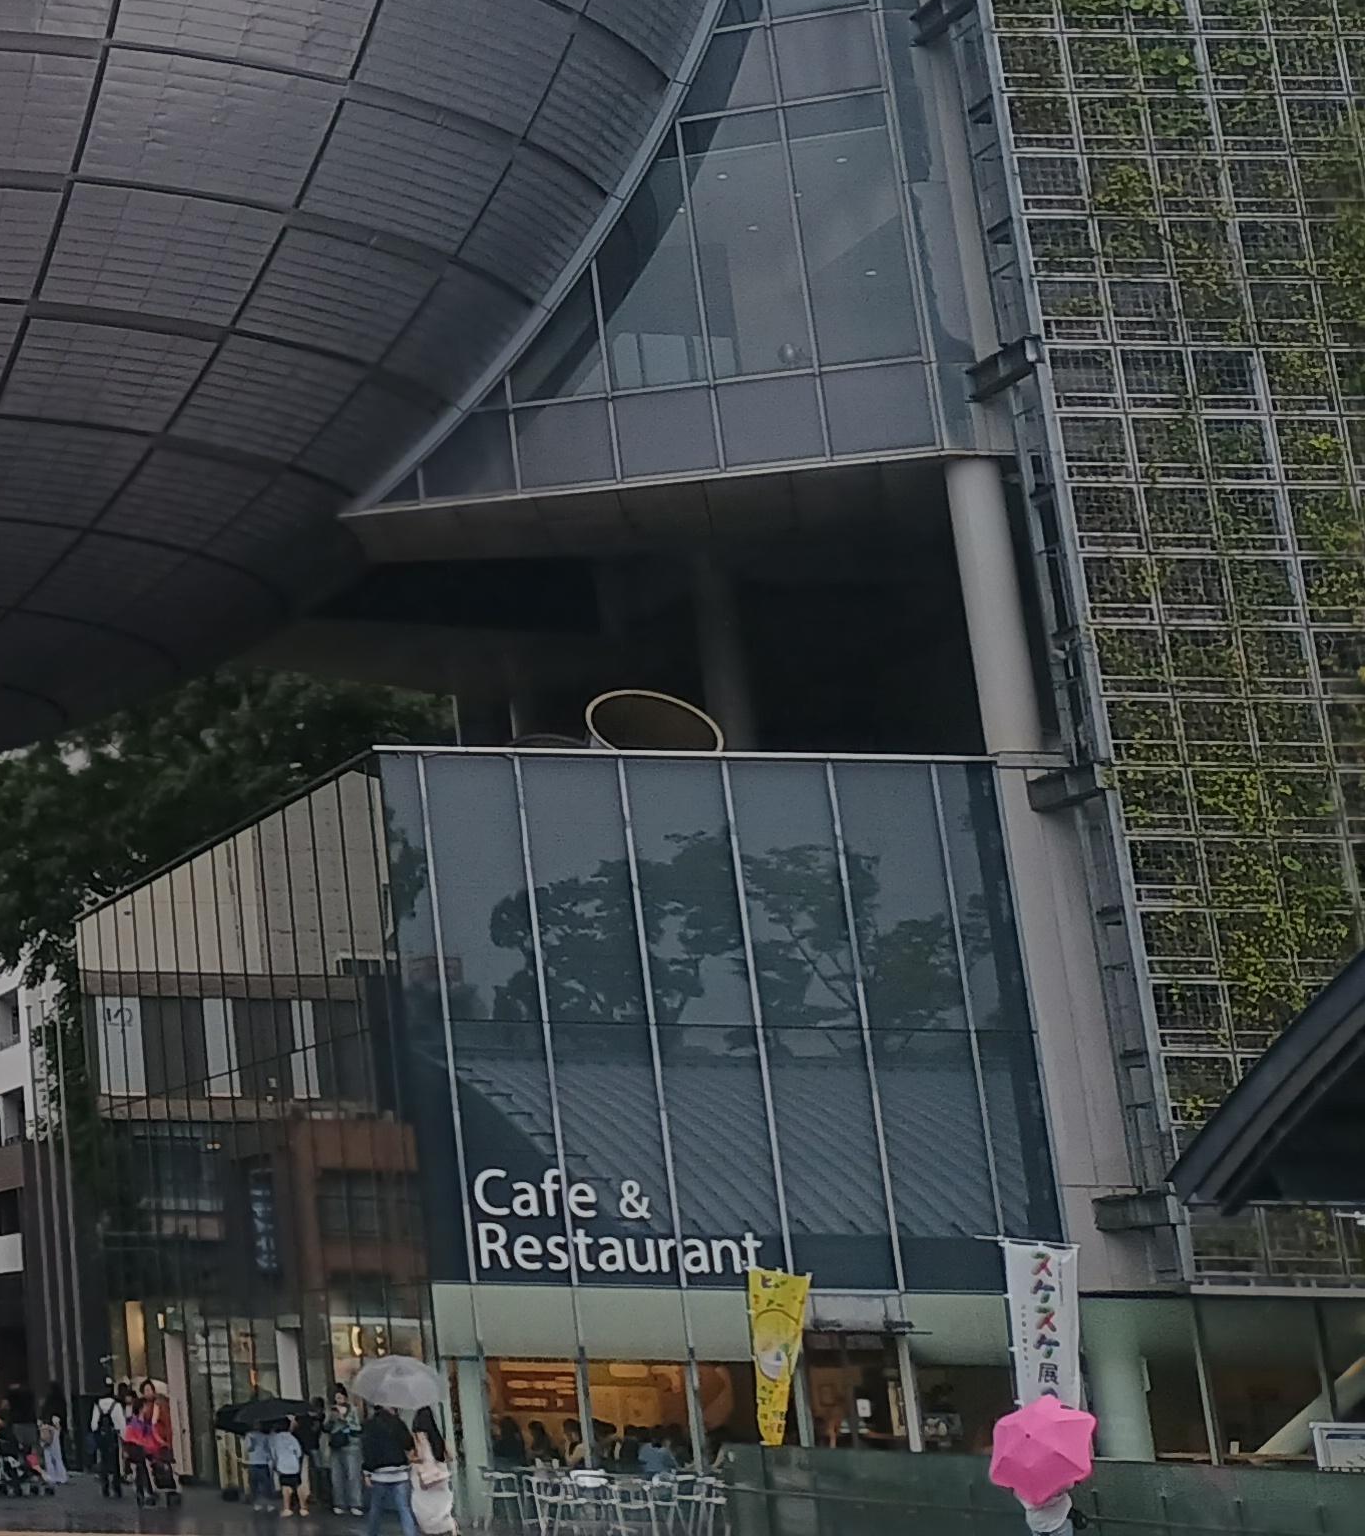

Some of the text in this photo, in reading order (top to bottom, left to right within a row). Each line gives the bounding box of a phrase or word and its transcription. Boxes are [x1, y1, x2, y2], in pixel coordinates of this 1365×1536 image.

[473, 1168, 652, 1220] Cafe &
[477, 1222, 764, 1275] Restaurant
